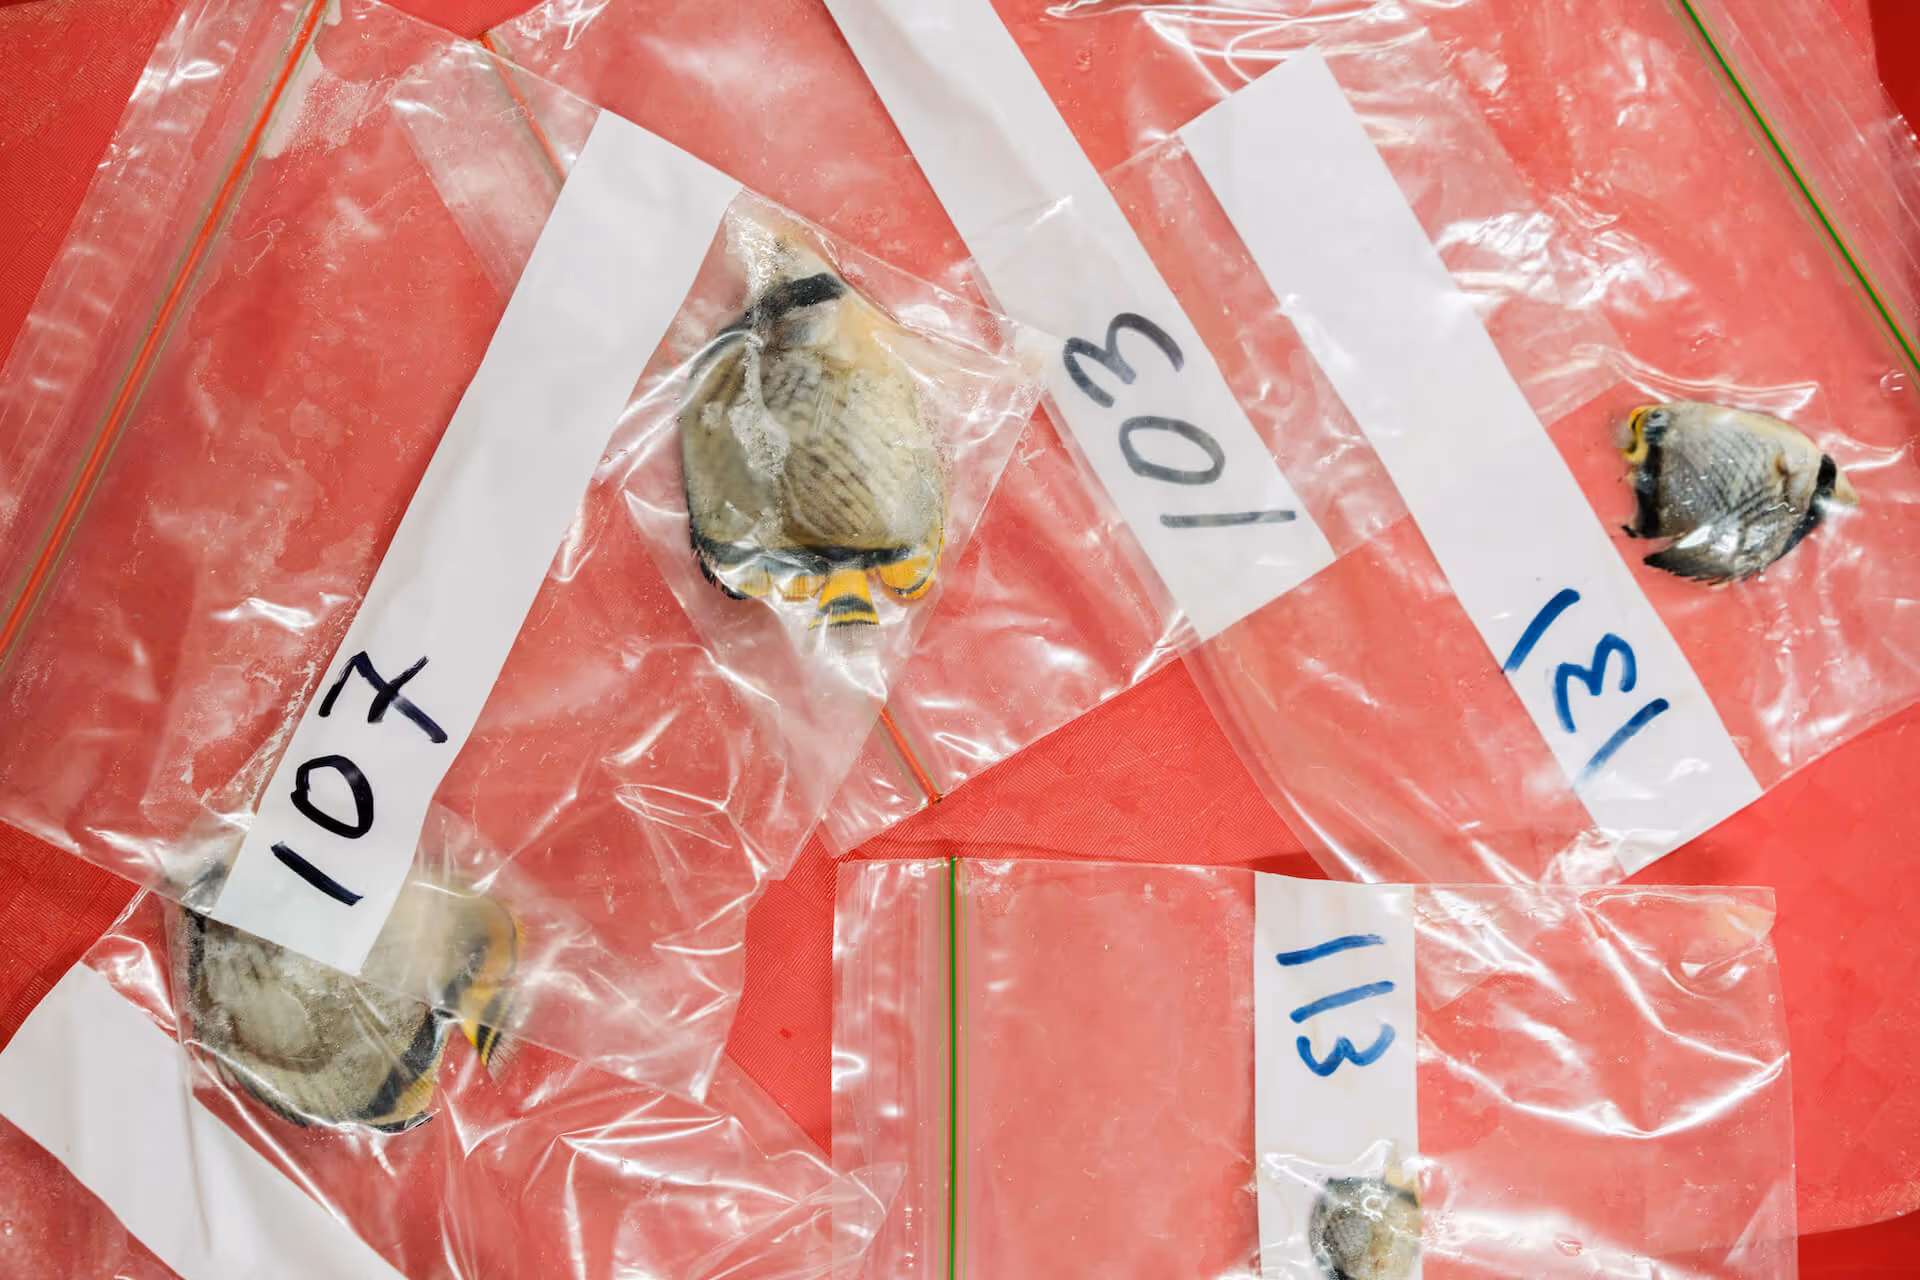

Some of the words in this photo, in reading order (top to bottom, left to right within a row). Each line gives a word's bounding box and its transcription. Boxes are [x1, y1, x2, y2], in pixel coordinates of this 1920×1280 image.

[1062, 312, 1297, 529] 103
[270, 650, 448, 907] 107
[1502, 588, 1669, 792] 131
[1276, 933, 1396, 1078] 113
